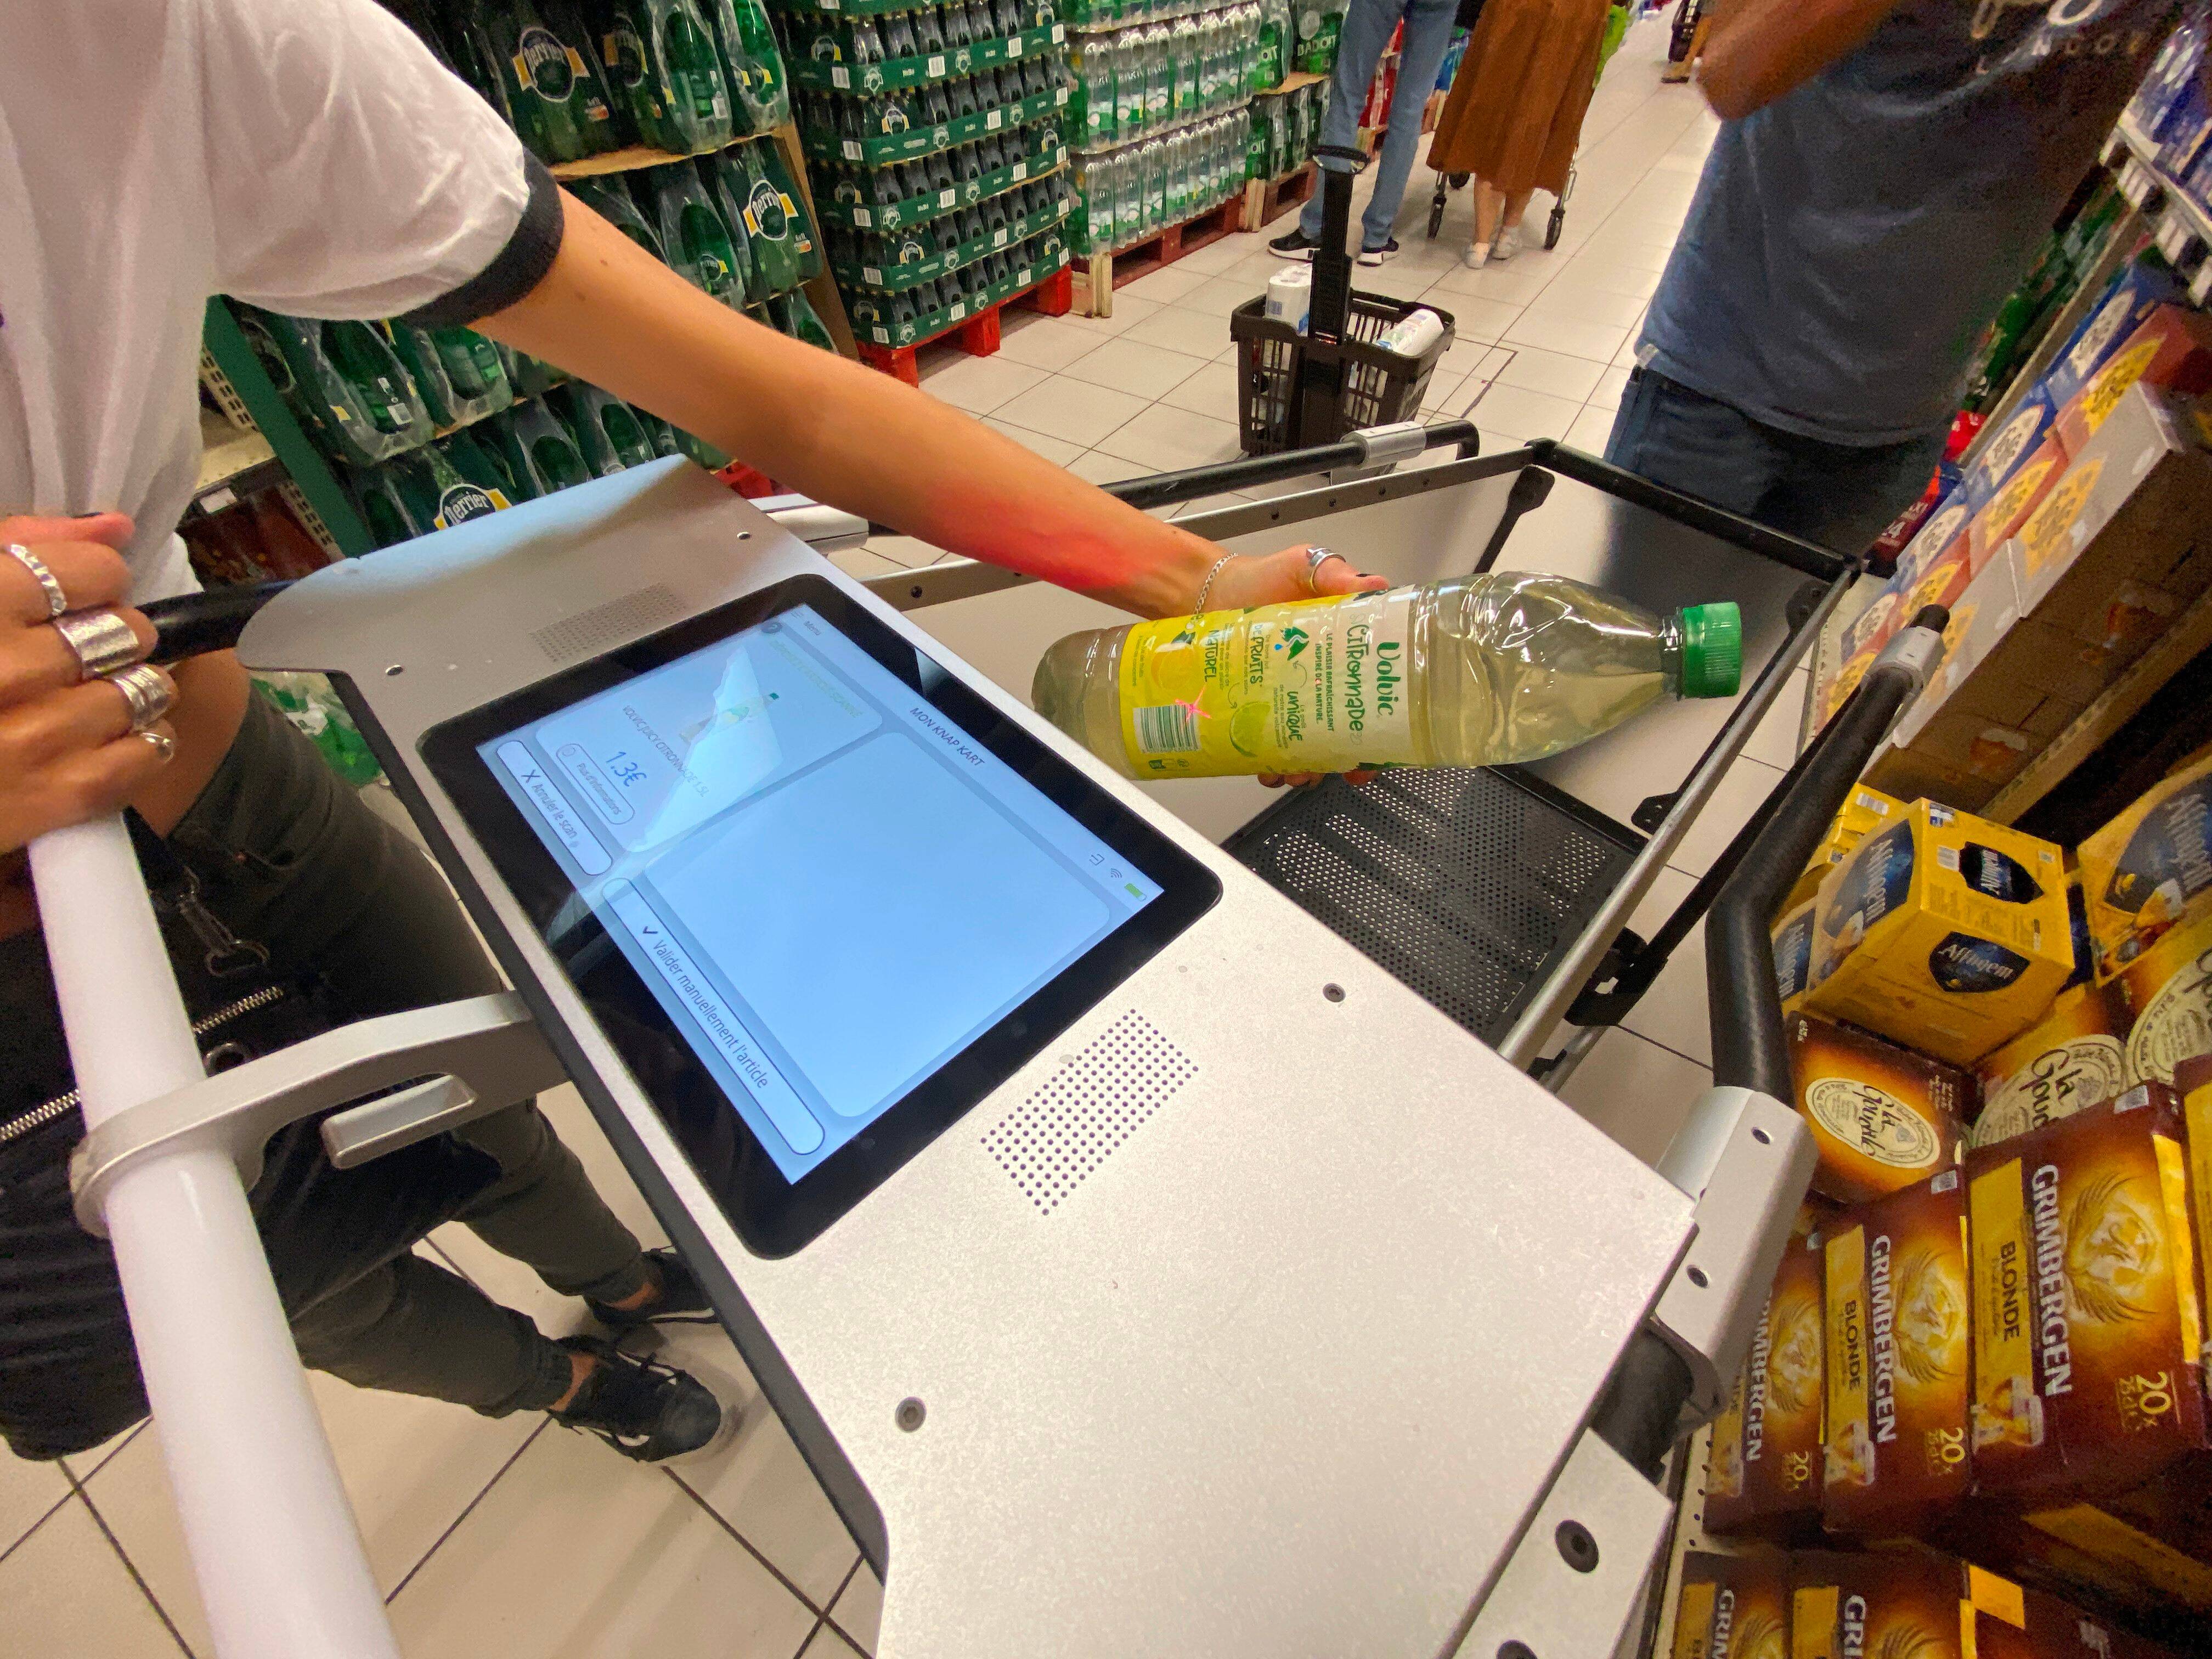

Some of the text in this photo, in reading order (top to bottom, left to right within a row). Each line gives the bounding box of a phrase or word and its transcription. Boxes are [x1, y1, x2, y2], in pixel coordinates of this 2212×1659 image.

[1376, 641, 1401, 716] Volvic
[605, 750, 647, 787] 1.3€
[909, 707, 986, 766] MON KNAP KART
[552, 809, 565, 821] le
[558, 819, 578, 839] scan
[653, 939, 769, 1088] Valider manuellement l'article
[1999, 1240, 2020, 1343] BLONDE
[2031, 1163, 2073, 1398] GRIMBERGEN
[1844, 1299, 1861, 1391] BLONDE
[1870, 1234, 1898, 1444] GRIMBERGEN
